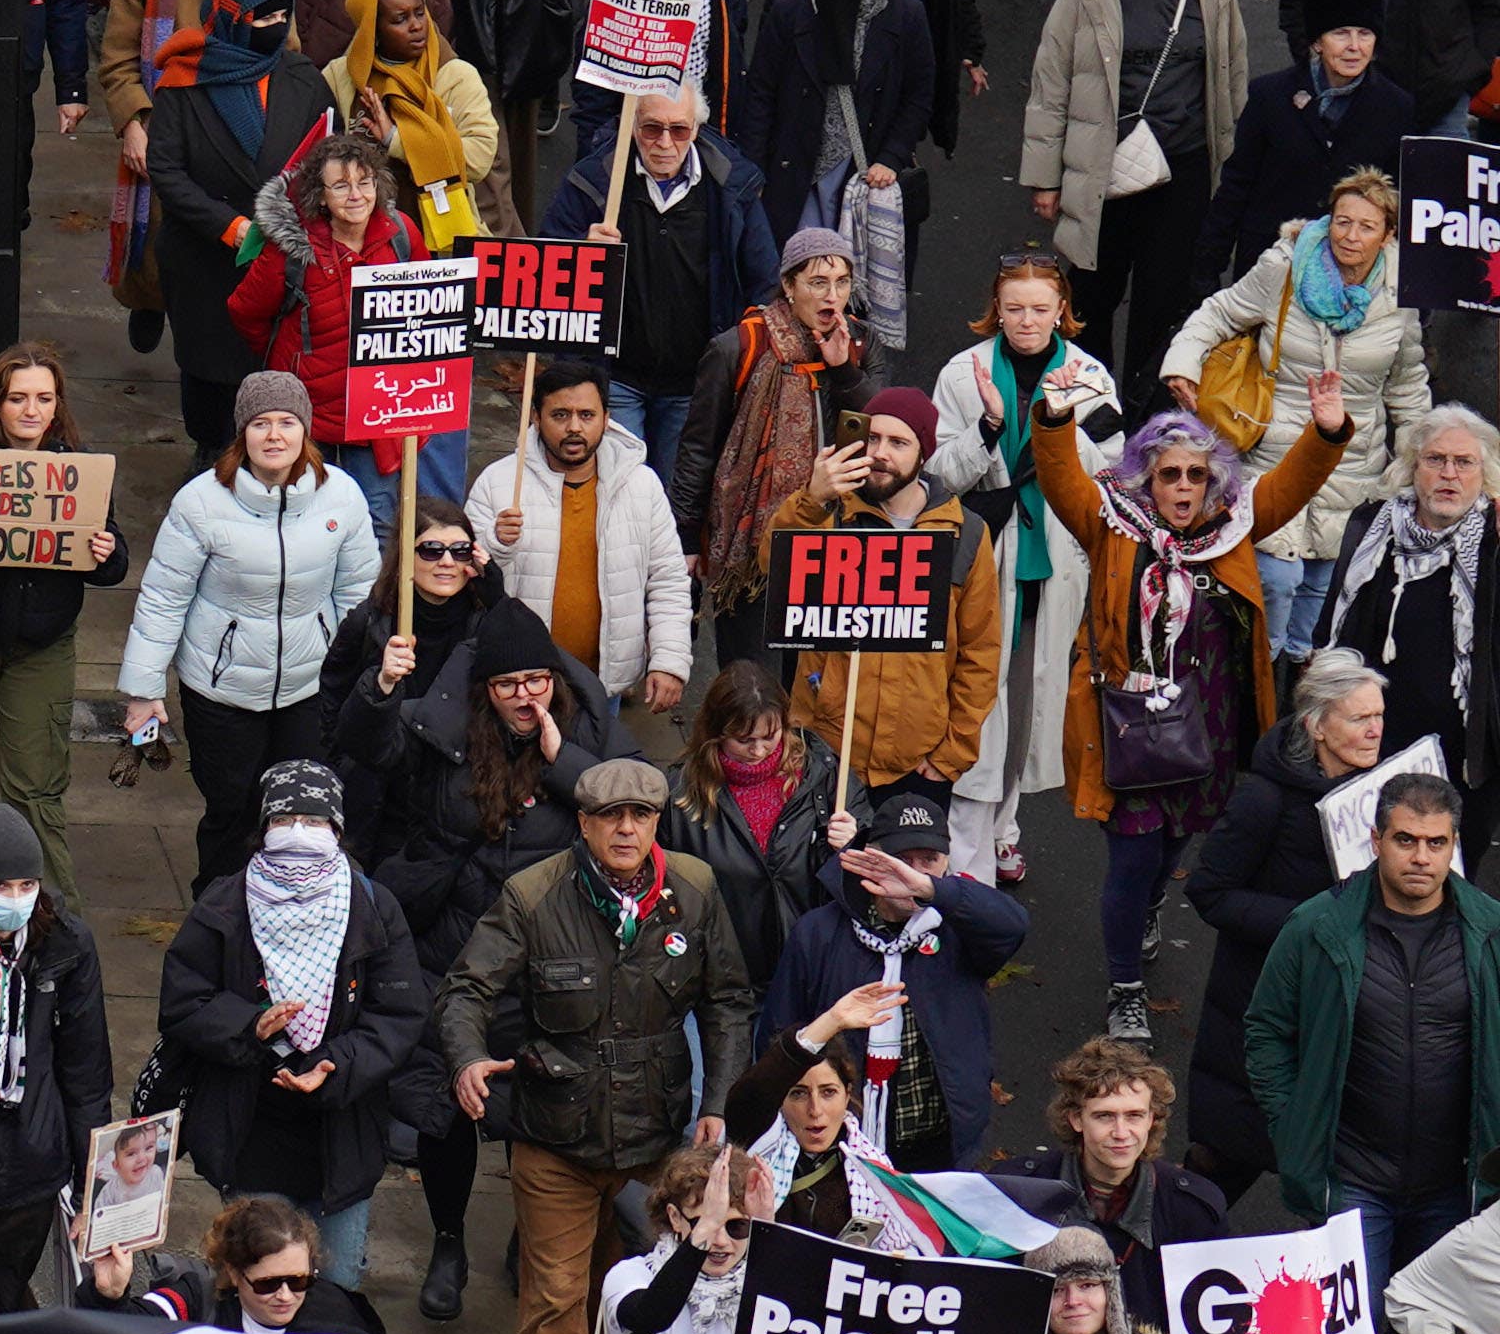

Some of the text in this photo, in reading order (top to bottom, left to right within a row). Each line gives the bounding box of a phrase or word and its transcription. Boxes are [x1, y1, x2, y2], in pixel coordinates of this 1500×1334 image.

[371, 266, 458, 283] Socialist Worker
[474, 242, 607, 312] FREE
[363, 287, 464, 318] FREEDOM
[474, 308, 600, 342] PALESTINE
[357, 328, 467, 360] PALESTINE
[374, 368, 446, 396] الحرية
[363, 393, 455, 426] لفلسطين
[17, 459, 36, 486] IS
[46, 463, 79, 491] NO
[789, 535, 932, 605] FREE
[785, 606, 927, 638] PALESTINE
[826, 1261, 962, 1324] Free
